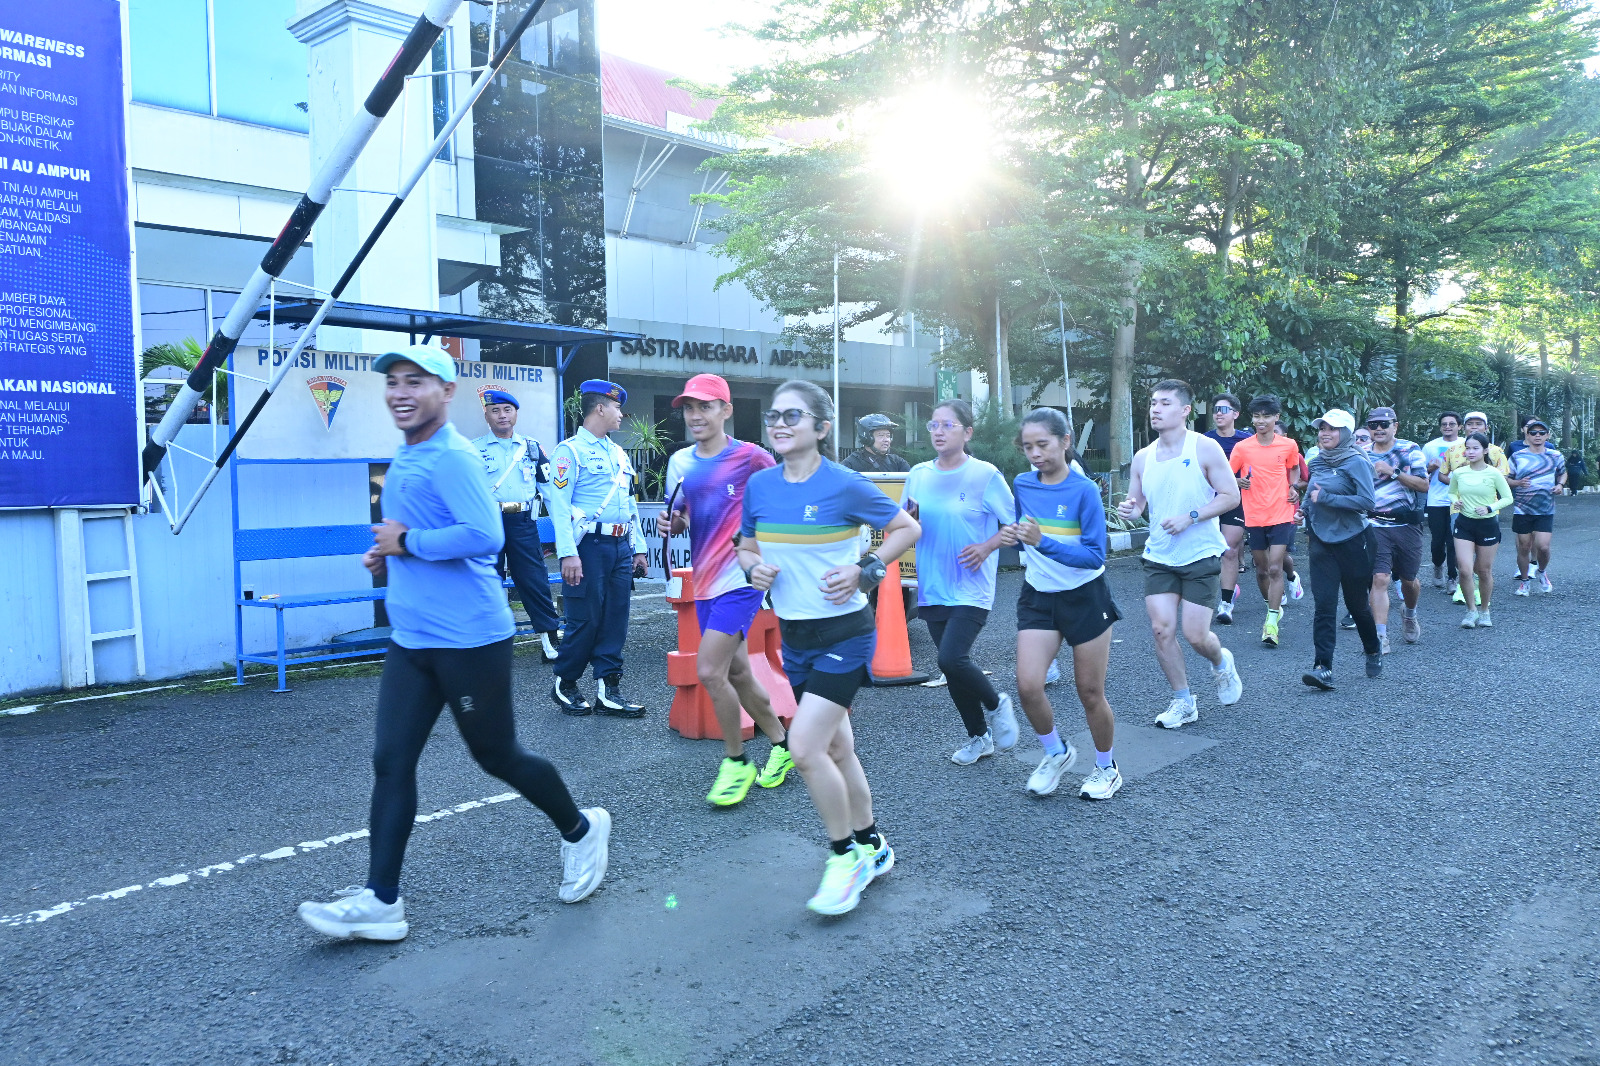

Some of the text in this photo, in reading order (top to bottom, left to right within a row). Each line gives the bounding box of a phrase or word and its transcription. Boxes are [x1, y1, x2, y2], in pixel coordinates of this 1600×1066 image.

[0, 45, 52, 68] RMASI
[19, 85, 78, 106] INFORMASI
[21, 110, 75, 129] BERSIKAP
[1, 119, 73, 141] BIJAK DALAM
[12, 158, 33, 174] AU
[37, 162, 91, 182] AMPUH
[2, 180, 79, 201] TNI AU AMPUH
[36, 198, 82, 213] MELALUI
[24, 209, 71, 225] VALIDASI
[39, 294, 67, 307] DAYA
[0, 304, 77, 321] PROFESIONAL,
[0, 316, 97, 333] PU MENGIMBANGI
[10, 329, 49, 342] TUGAS
[51, 332, 85, 344] SERTA
[58, 344, 87, 356] YANG
[620, 337, 760, 365] SASTRANEGARA
[492, 364, 543, 383] MILITER
[41, 380, 117, 395] NASIONAL
[24, 400, 70, 412] MELALUI
[18, 413, 70, 425] HUMANIS,
[6, 425, 64, 436] TERHADAP
[12, 450, 45, 460] MAJU.
